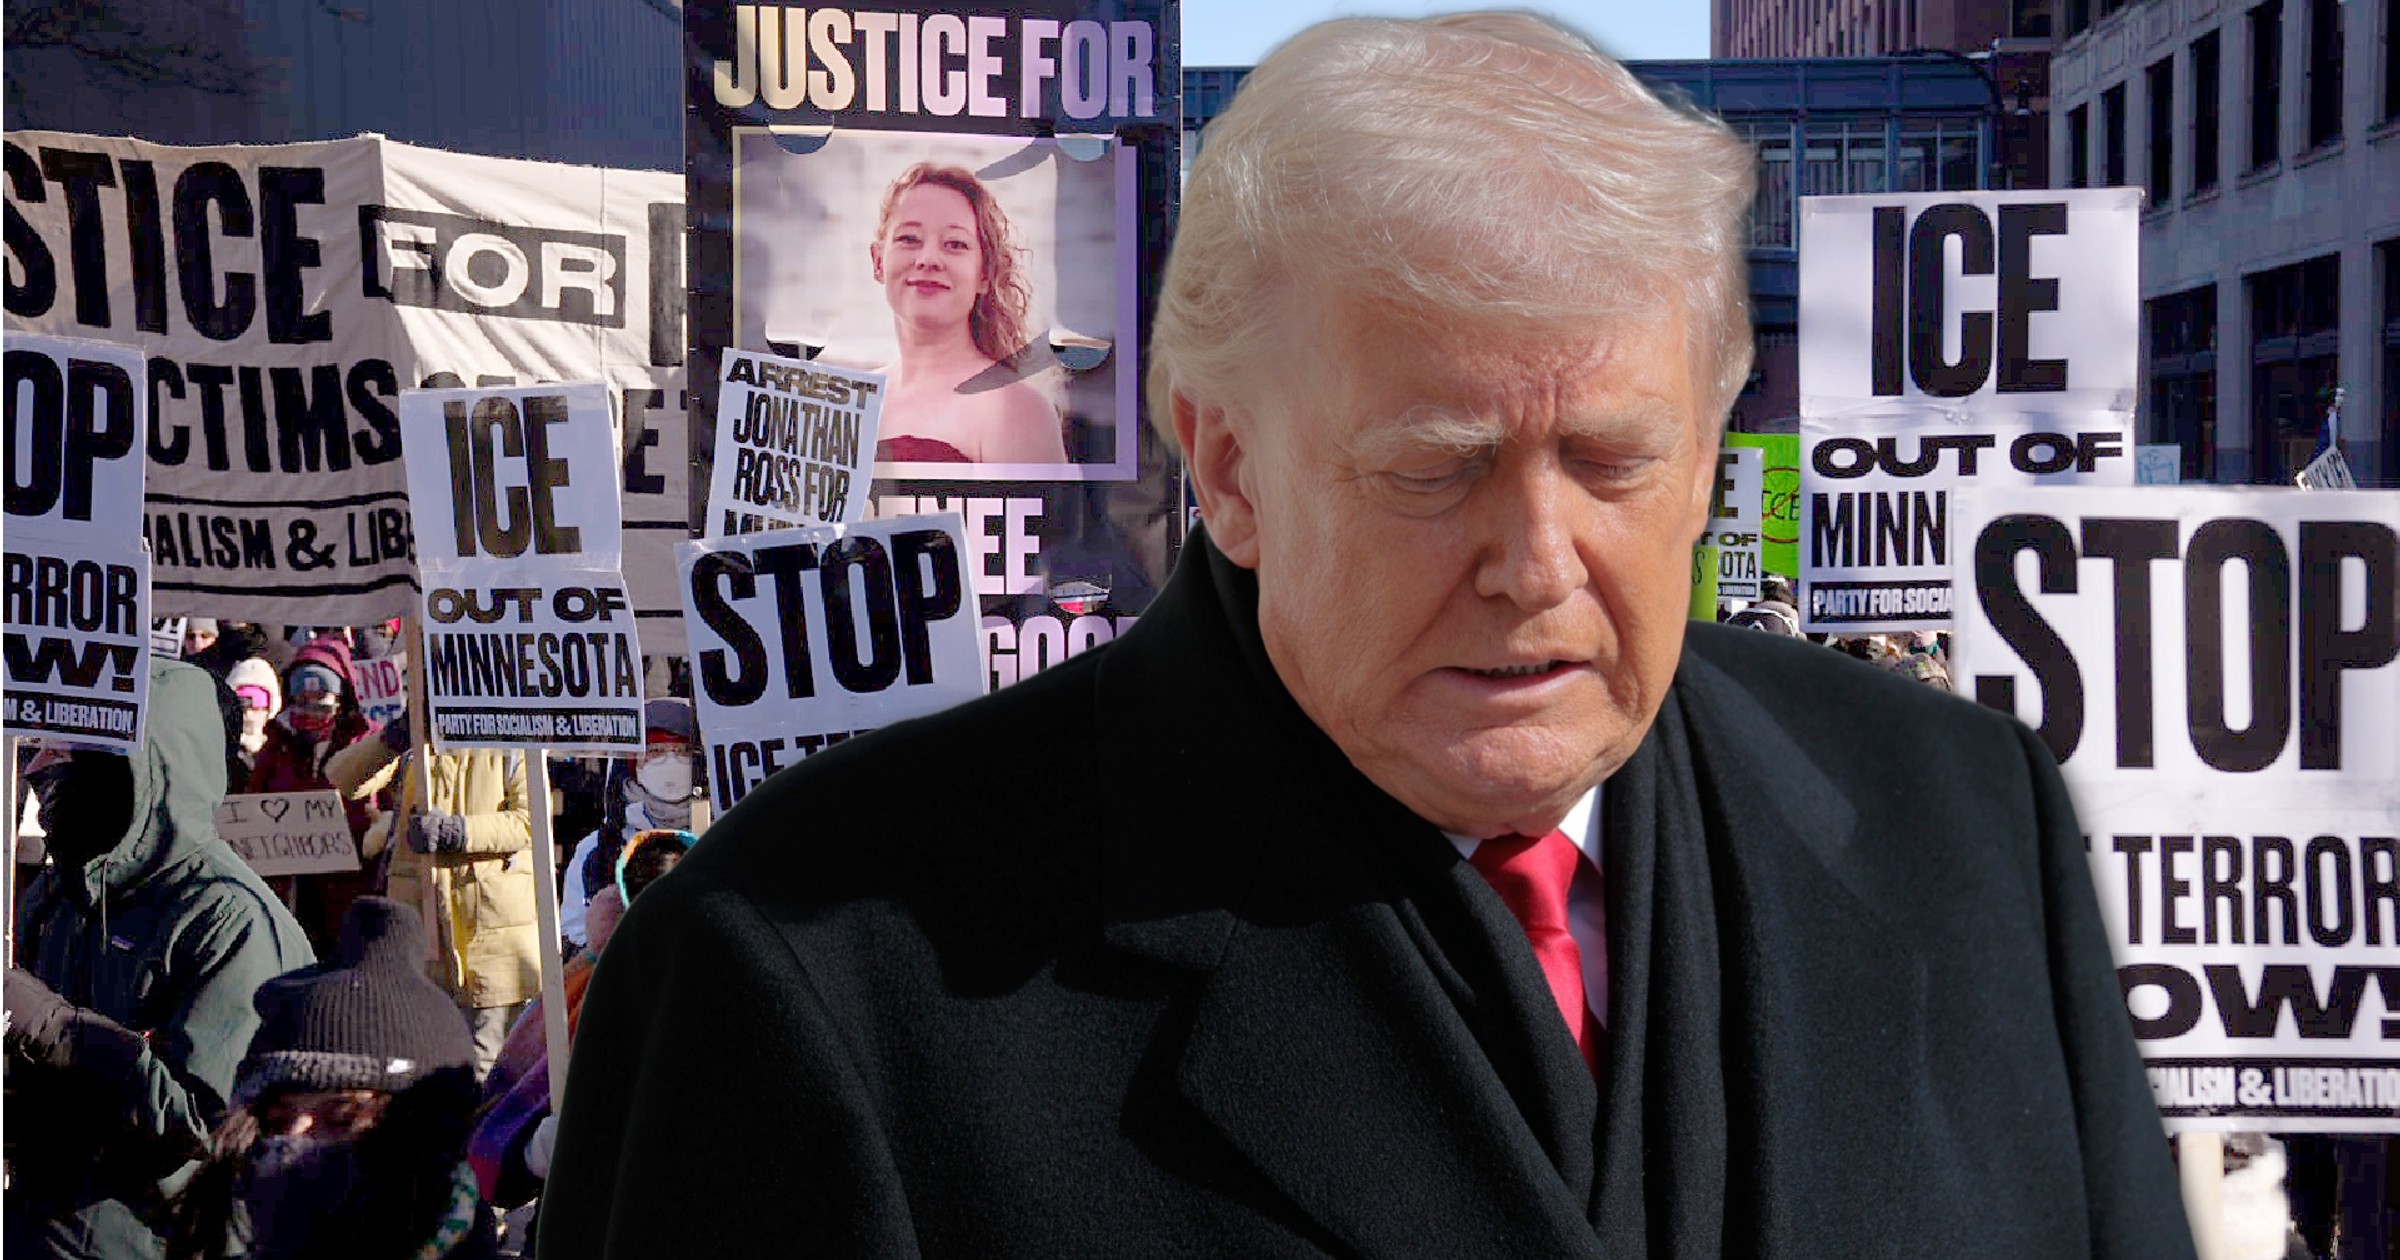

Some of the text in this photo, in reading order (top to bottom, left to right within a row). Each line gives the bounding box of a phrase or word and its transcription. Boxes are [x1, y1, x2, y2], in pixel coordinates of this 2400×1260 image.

[713, 5, 1154, 119] JUSTICE FOR
[3, 141, 333, 343] STICE
[382, 222, 619, 318] FOR
[1872, 201, 2068, 398] ICE
[726, 358, 877, 409] ARREST
[3, 350, 134, 520] OP
[733, 391, 861, 469] JONATHAN
[1812, 431, 2123, 479] OUT OF
[443, 395, 582, 558] ICE
[733, 447, 800, 513] ROSS
[803, 462, 850, 522] FOR
[285, 518, 337, 572] &
[1719, 532, 1757, 546] OF
[3, 552, 137, 637] RROR
[428, 587, 626, 623] OUT OF
[691, 530, 961, 706] STOP
[1813, 588, 1868, 616] PARTY
[1869, 588, 1903, 614] FOR
[431, 632, 637, 698] MINNESOTA
[1974, 514, 2400, 773] STOP
[20, 699, 42, 722] &
[45, 700, 134, 732] LIBERATION
[437, 713, 637, 738] PARTY FOR SOCIALISM & LIBERATION
[222, 800, 336, 823] I MY
[2112, 836, 2400, 947] TERROR
[2238, 1067, 2273, 1107] &
